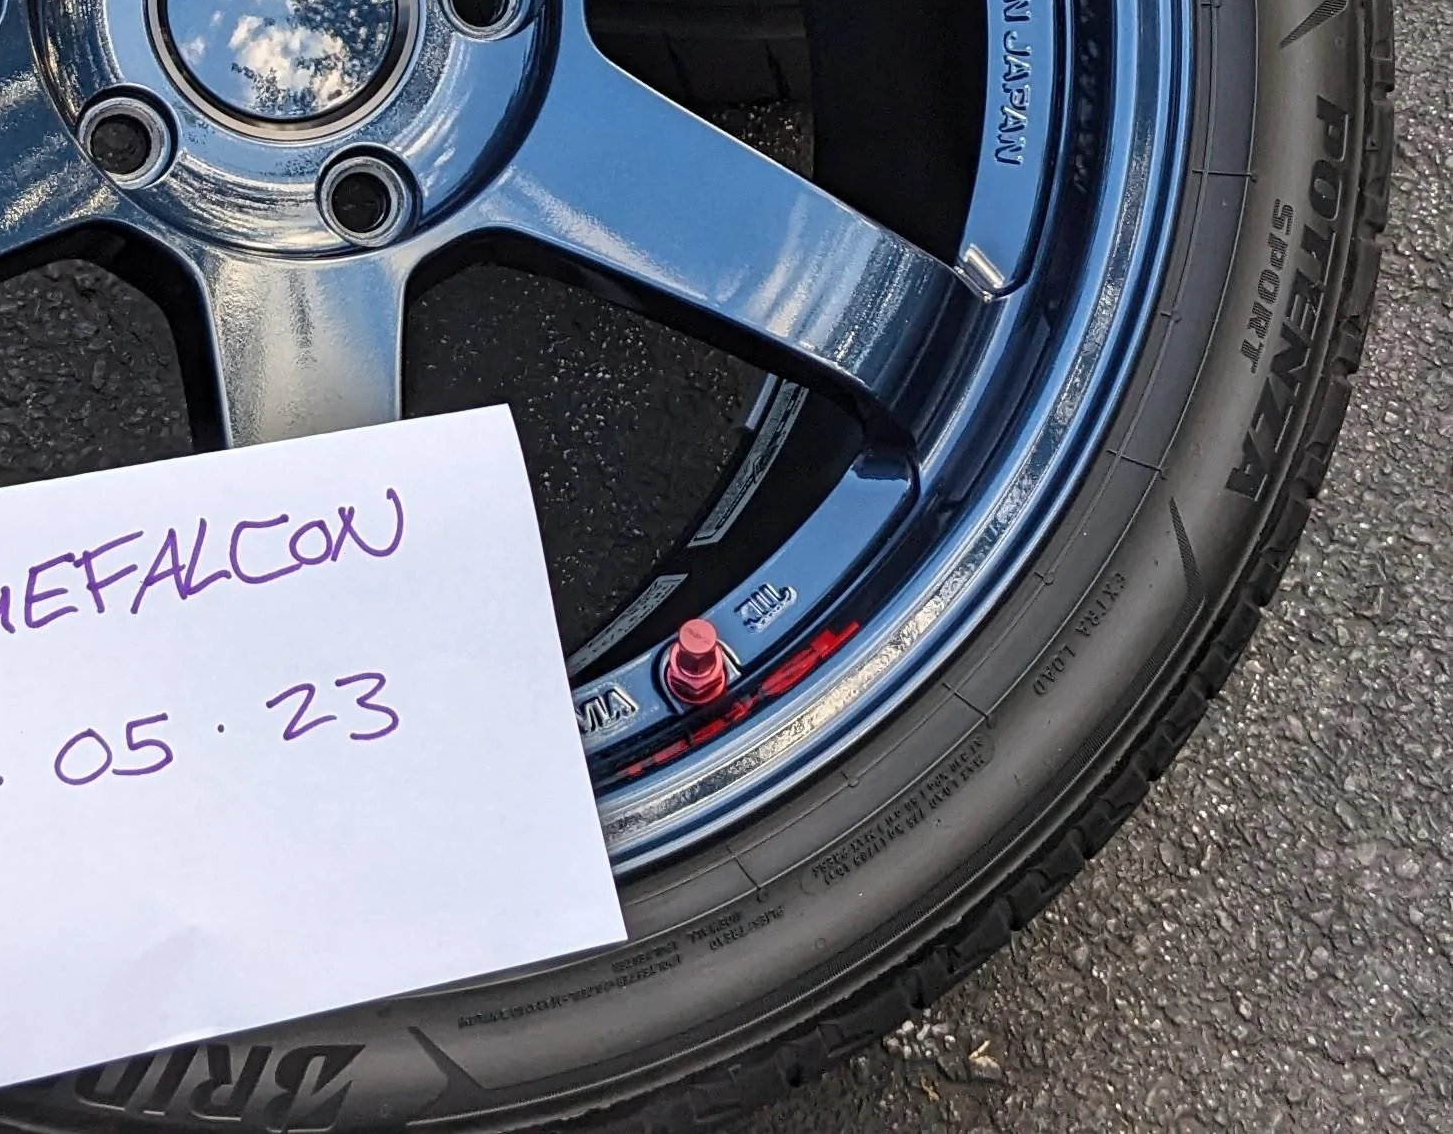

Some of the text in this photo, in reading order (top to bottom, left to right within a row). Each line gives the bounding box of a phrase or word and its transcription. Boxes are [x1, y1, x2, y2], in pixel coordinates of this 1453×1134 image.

[993, 29, 1034, 168] JAPAN
[1226, 97, 1350, 503] POTENZA
[1248, 199, 1294, 373] SPORT
[1032, 570, 1129, 698] EXTRA LOAD
